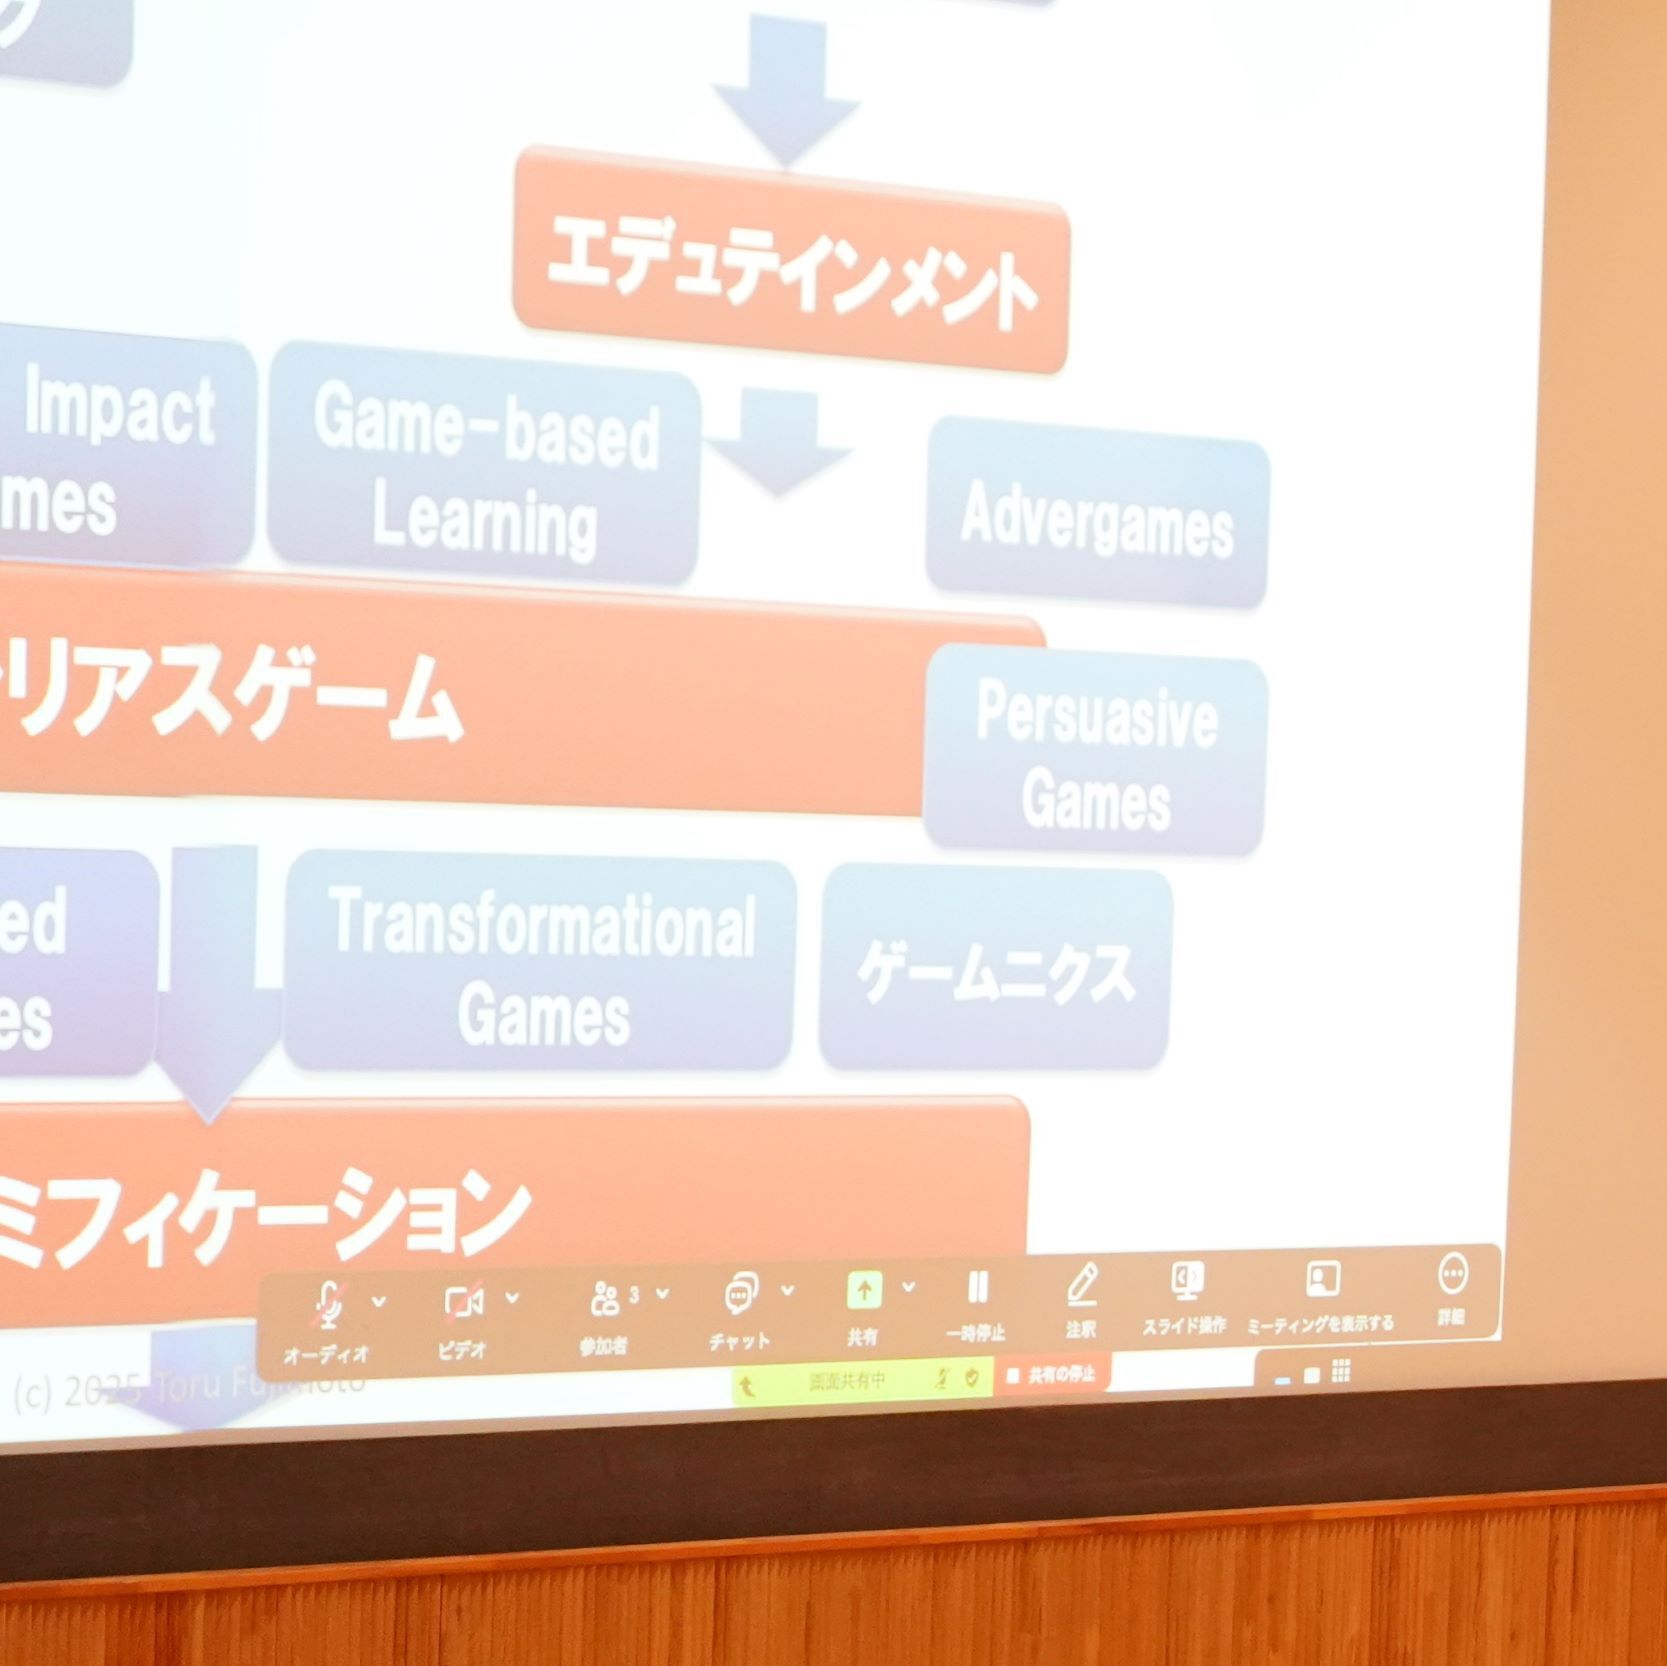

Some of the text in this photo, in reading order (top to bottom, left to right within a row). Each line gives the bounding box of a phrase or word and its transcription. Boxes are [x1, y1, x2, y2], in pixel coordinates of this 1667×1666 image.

[548, 215, 1039, 332] エデュテインメント
[26, 362, 216, 446] Impact
[314, 379, 660, 471] Game-based
[373, 477, 598, 565] Learning
[959, 479, 1235, 560] Advergames
[0, 637, 465, 743] リアスゲーム
[977, 677, 1220, 751] Persuasive
[1021, 765, 1171, 832] Games
[328, 885, 756, 959] Transformational
[857, 939, 1137, 1006] ゲームニクス
[458, 980, 631, 1047] Games
[284, 1344, 369, 1365] オーディオ
[438, 1340, 487, 1361] ビデオ
[579, 1336, 629, 1357] 参加者
[709, 1332, 770, 1351] チャット
[847, 1327, 879, 1347] 共有
[946, 1323, 1006, 1343] 一時停止
[1143, 1315, 1227, 1336] スライド操作
[1248, 1314, 1395, 1335] ミーティングを表示する
[14, 1373, 51, 1416] (c)
[1029, 1364, 1096, 1385] 共有の停止
